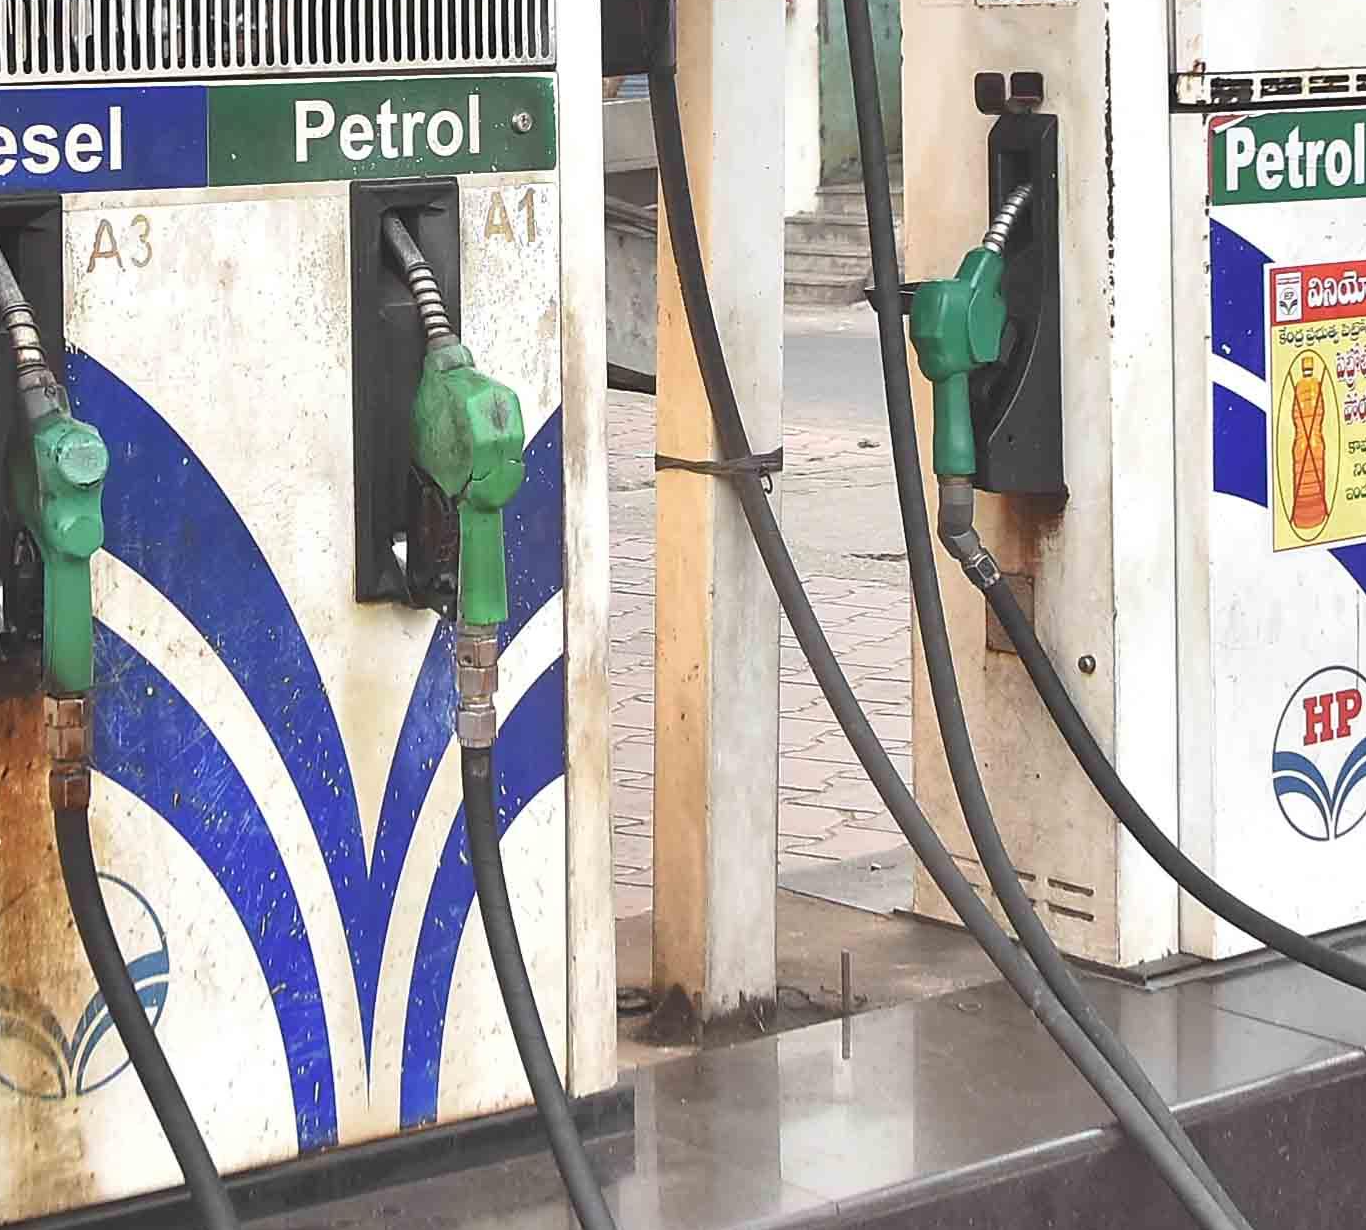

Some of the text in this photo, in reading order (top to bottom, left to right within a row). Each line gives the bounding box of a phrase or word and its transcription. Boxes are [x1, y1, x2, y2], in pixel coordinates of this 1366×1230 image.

[294, 95, 480, 162] Petrol
[1225, 122, 1365, 192] Petrol
[88, 213, 153, 273] A3
[485, 187, 538, 244] A1
[1303, 688, 1362, 747] HP
